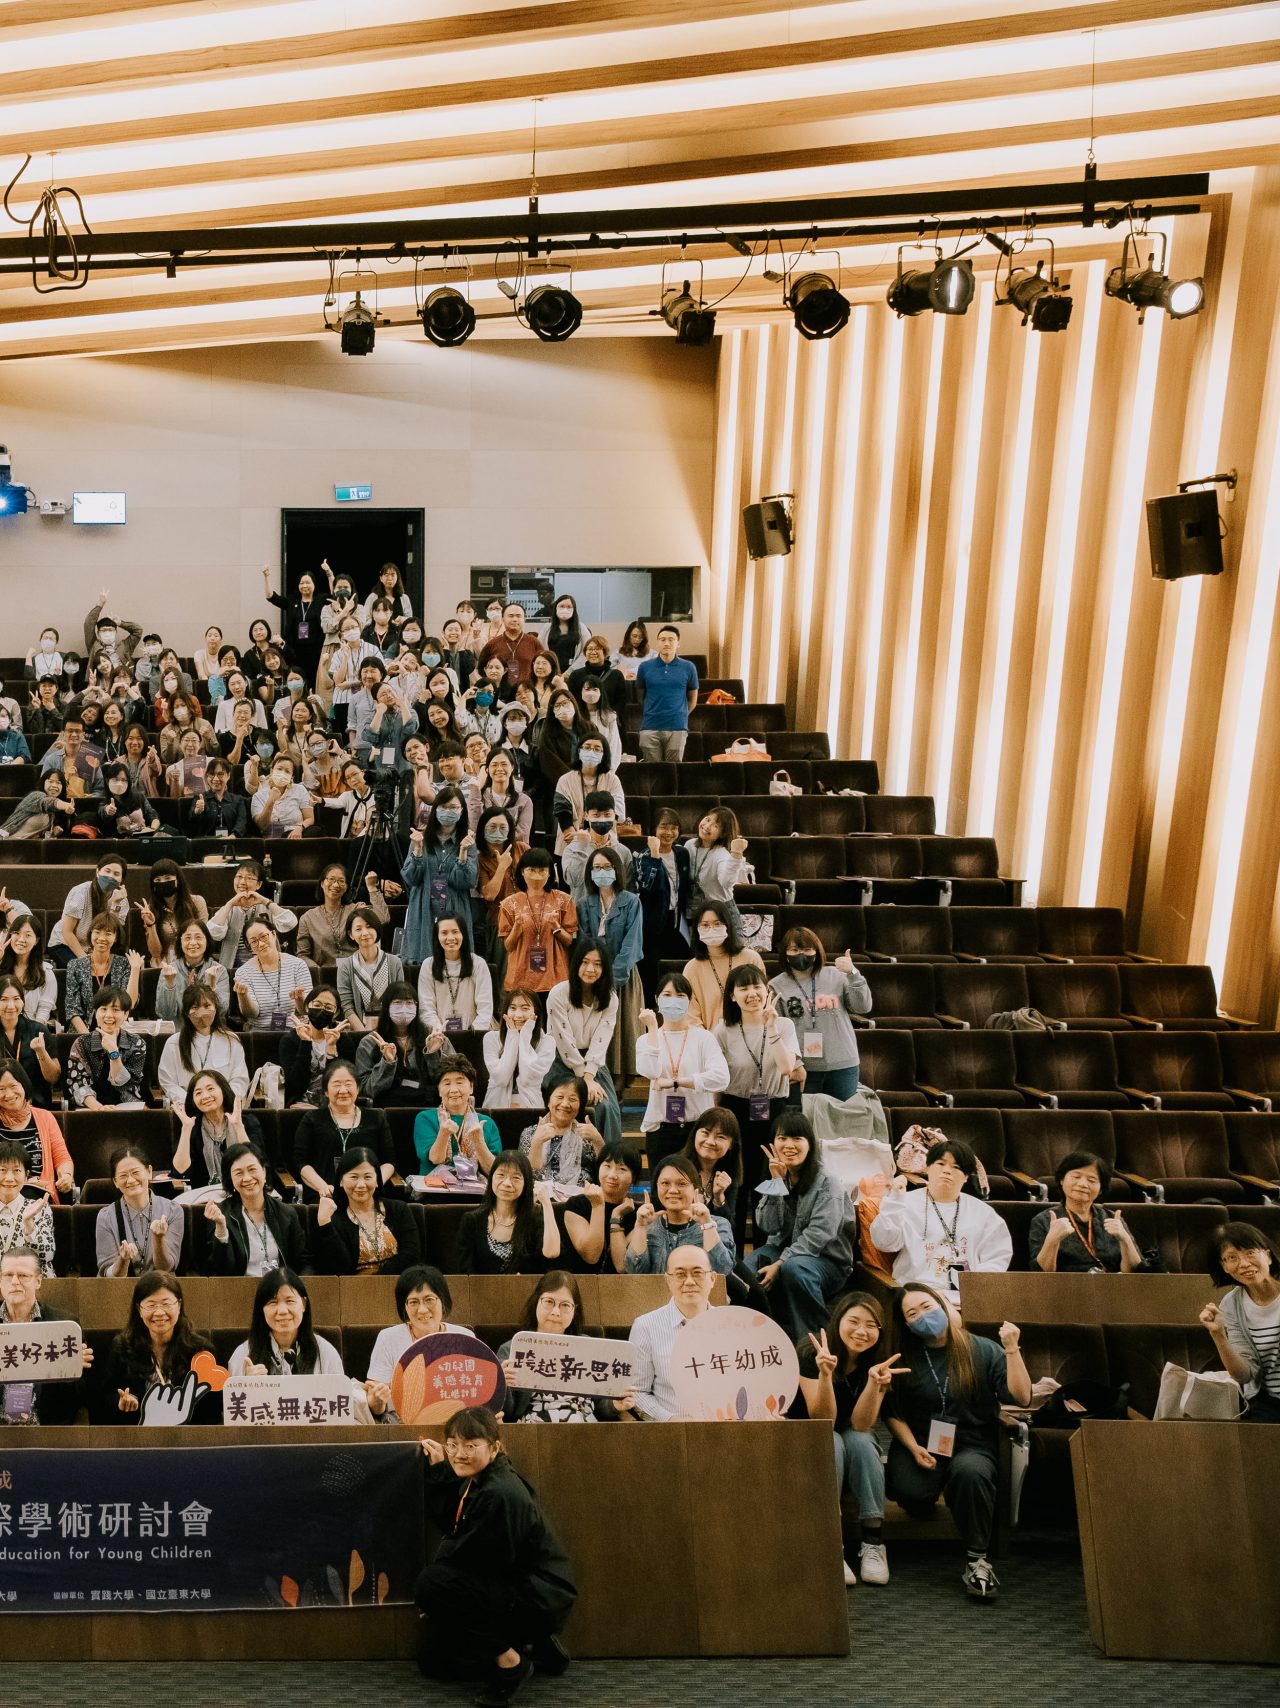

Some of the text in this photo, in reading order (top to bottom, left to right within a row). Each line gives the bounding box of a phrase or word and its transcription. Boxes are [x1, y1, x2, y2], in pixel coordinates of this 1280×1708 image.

[438, 1359, 475, 1372] 幼兒園
[512, 1350, 632, 1383] 跨越新思維
[684, 1345, 783, 1378] 十年幼成
[433, 1374, 483, 1388] 美感教育
[227, 1392, 350, 1425] 美感無極限
[69, 1547, 89, 1560] for
[98, 1547, 143, 1562] Young
[151, 1546, 212, 1559] Children
